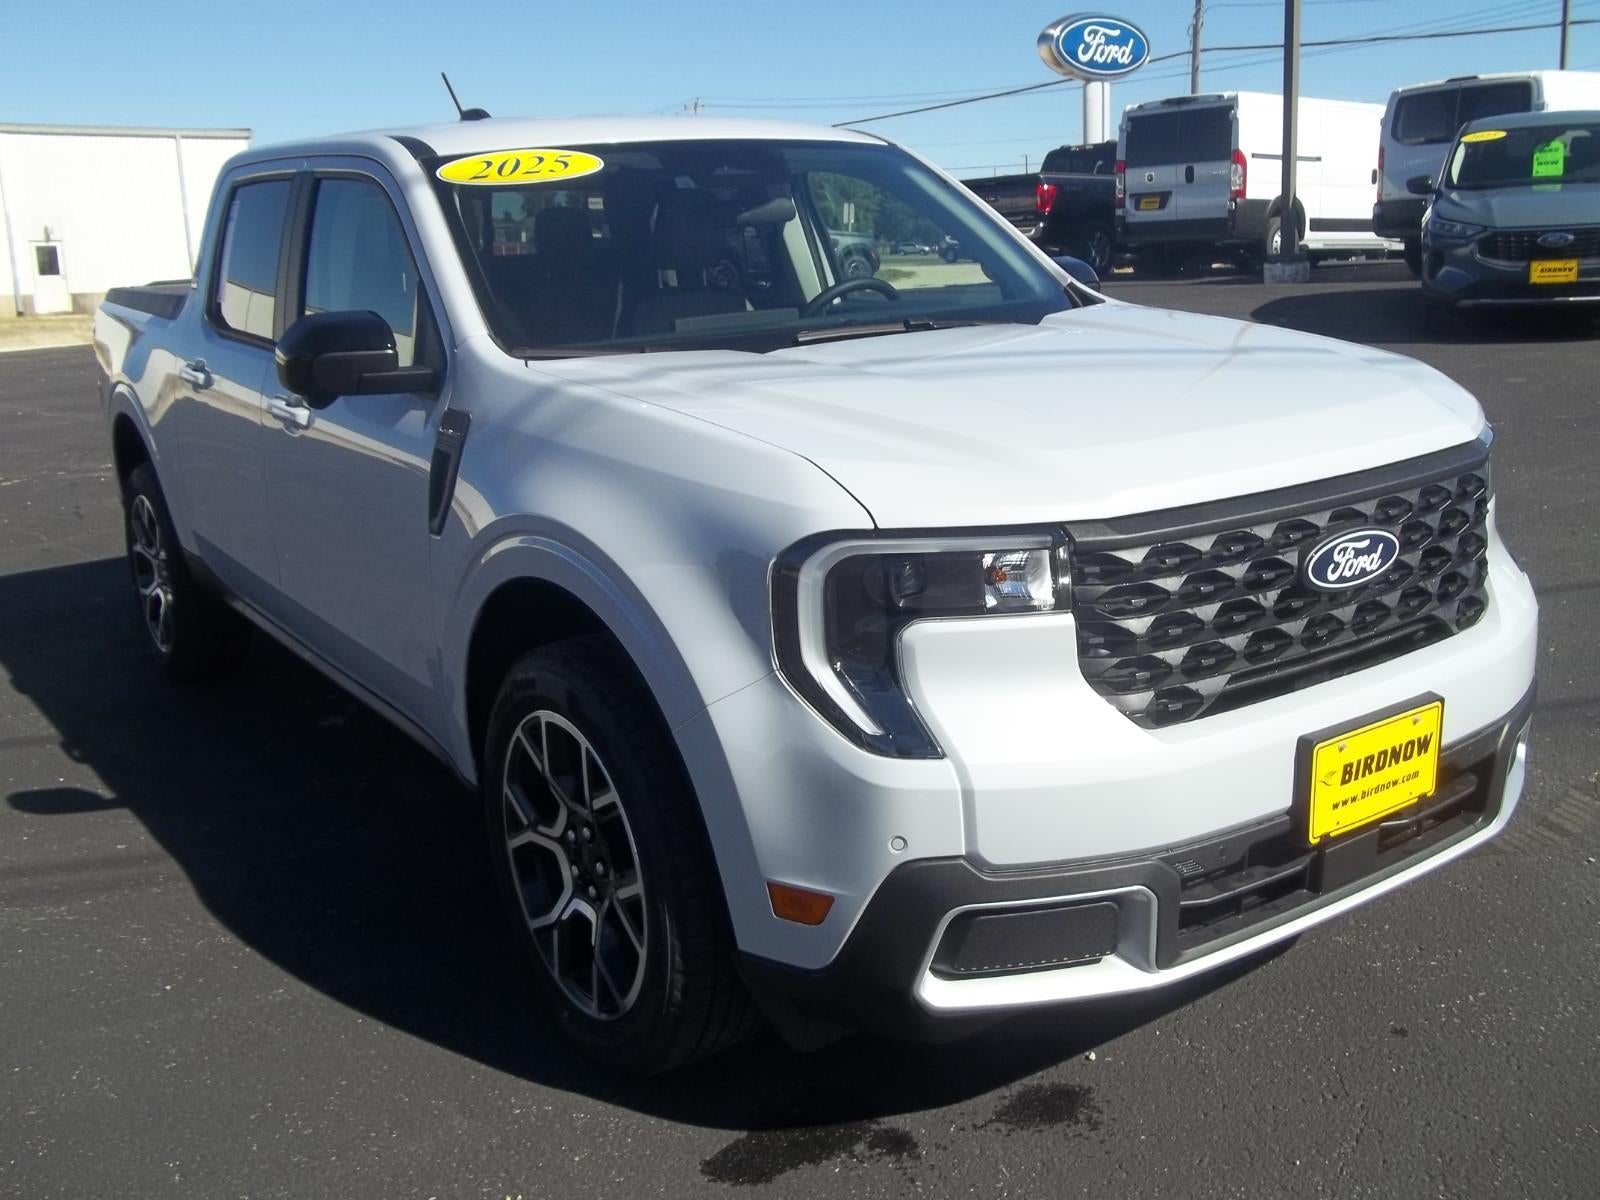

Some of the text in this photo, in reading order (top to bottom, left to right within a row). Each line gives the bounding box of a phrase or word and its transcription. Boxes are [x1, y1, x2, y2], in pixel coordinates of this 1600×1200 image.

[1078, 25, 1134, 65] Ford
[468, 154, 572, 181] 2025
[1327, 538, 1384, 581] Ford
[1340, 731, 1434, 787] BIRDNOW
[1332, 770, 1420, 811] www.birdnow.com
